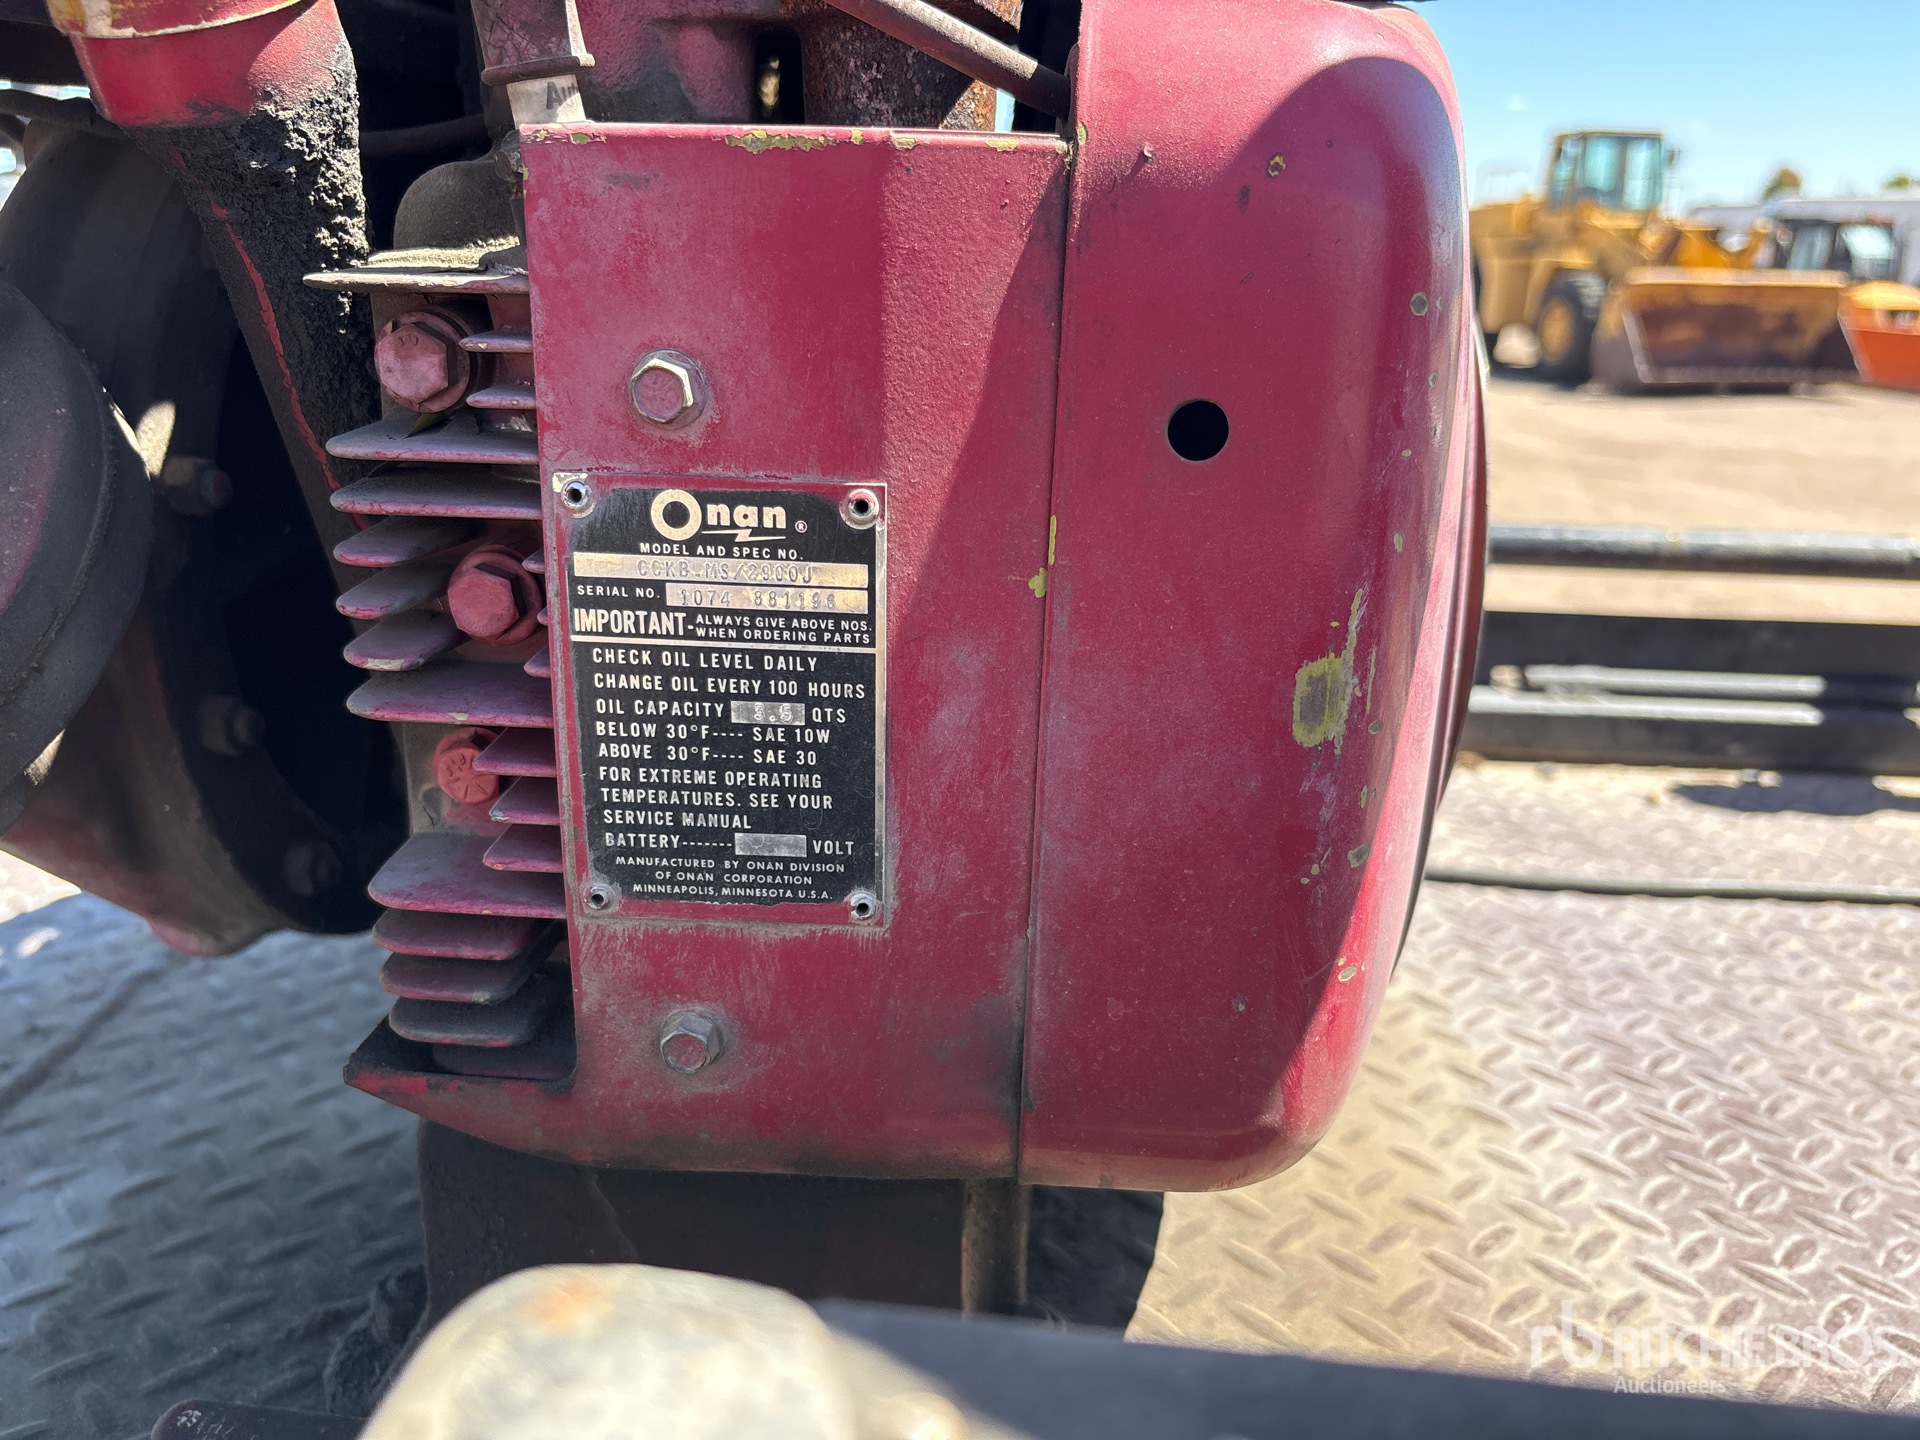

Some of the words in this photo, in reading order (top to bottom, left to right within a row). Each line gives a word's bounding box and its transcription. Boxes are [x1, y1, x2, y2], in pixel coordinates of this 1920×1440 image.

[651, 489, 787, 541] Onan
[640, 542, 690, 555] MODEL
[696, 545, 726, 556] AND
[733, 546, 771, 558] SPEC
[778, 548, 804, 560] NO.
[577, 585, 630, 596] SERIAL
[636, 587, 660, 598] NO.
[696, 614, 750, 626] ALWAYS
[755, 616, 786, 628] GIVE
[791, 618, 835, 630] ABOVE
[840, 620, 872, 631] NOS.
[696, 627, 737, 639] WHEN
[743, 629, 818, 642] ORDERING
[823, 632, 870, 644] PARTS
[593, 648, 652, 666] CHECK
[662, 652, 690, 667] OIL
[699, 653, 754, 669] LEVEL
[764, 655, 818, 671] DAILY
[594, 673, 663, 691] CHANGE
[672, 676, 699, 692] OIL
[707, 678, 761, 695] EVERY
[768, 680, 798, 696] 100
[808, 682, 866, 699] HOURS
[596, 699, 625, 715] OIL
[634, 700, 724, 718] CAPACITY
[812, 707, 846, 723] QTS
[596, 721, 657, 738] BELOW
[752, 727, 786, 742] SAE
[795, 728, 830, 743] 10W
[599, 743, 652, 759] ABOVE
[753, 749, 786, 764] SAE
[796, 750, 817, 765] 30
[600, 767, 631, 782] FOR
[639, 768, 717, 785] EXTREME
[725, 772, 822, 789] OPERATING
[750, 793, 781, 808] SEE
[787, 794, 833, 809] YOUR
[604, 809, 674, 825] SERVICE
[682, 812, 751, 829] MANUAL
[813, 840, 854, 855] VOLT
[616, 856, 715, 868] MANUFACTURED
[724, 860, 740, 869] BY
[746, 860, 784, 871] ONAN
[790, 863, 845, 872] DIVISION
[655, 870, 671, 880] OF
[676, 871, 714, 882] ONAN
[724, 873, 813, 884] CORPORATION
[721, 887, 794, 899] MINNESOTA
[798, 889, 833, 899] U.S.A.
